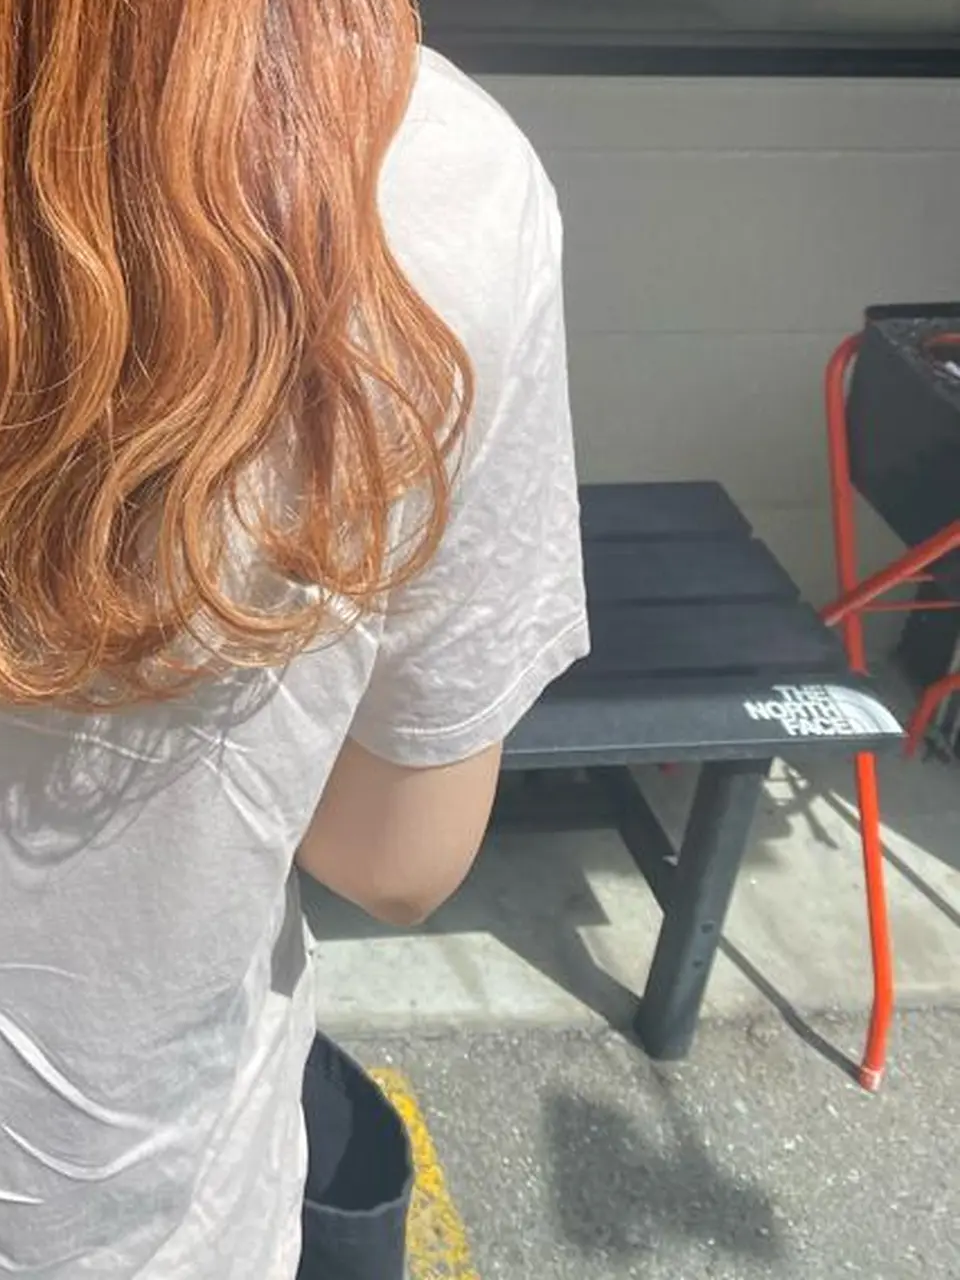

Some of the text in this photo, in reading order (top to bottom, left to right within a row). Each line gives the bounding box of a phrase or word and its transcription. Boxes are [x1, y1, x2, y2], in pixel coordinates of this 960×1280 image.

[772, 685, 828, 700] THE
[743, 699, 841, 720] NORTH
[780, 720, 853, 736] FACE
